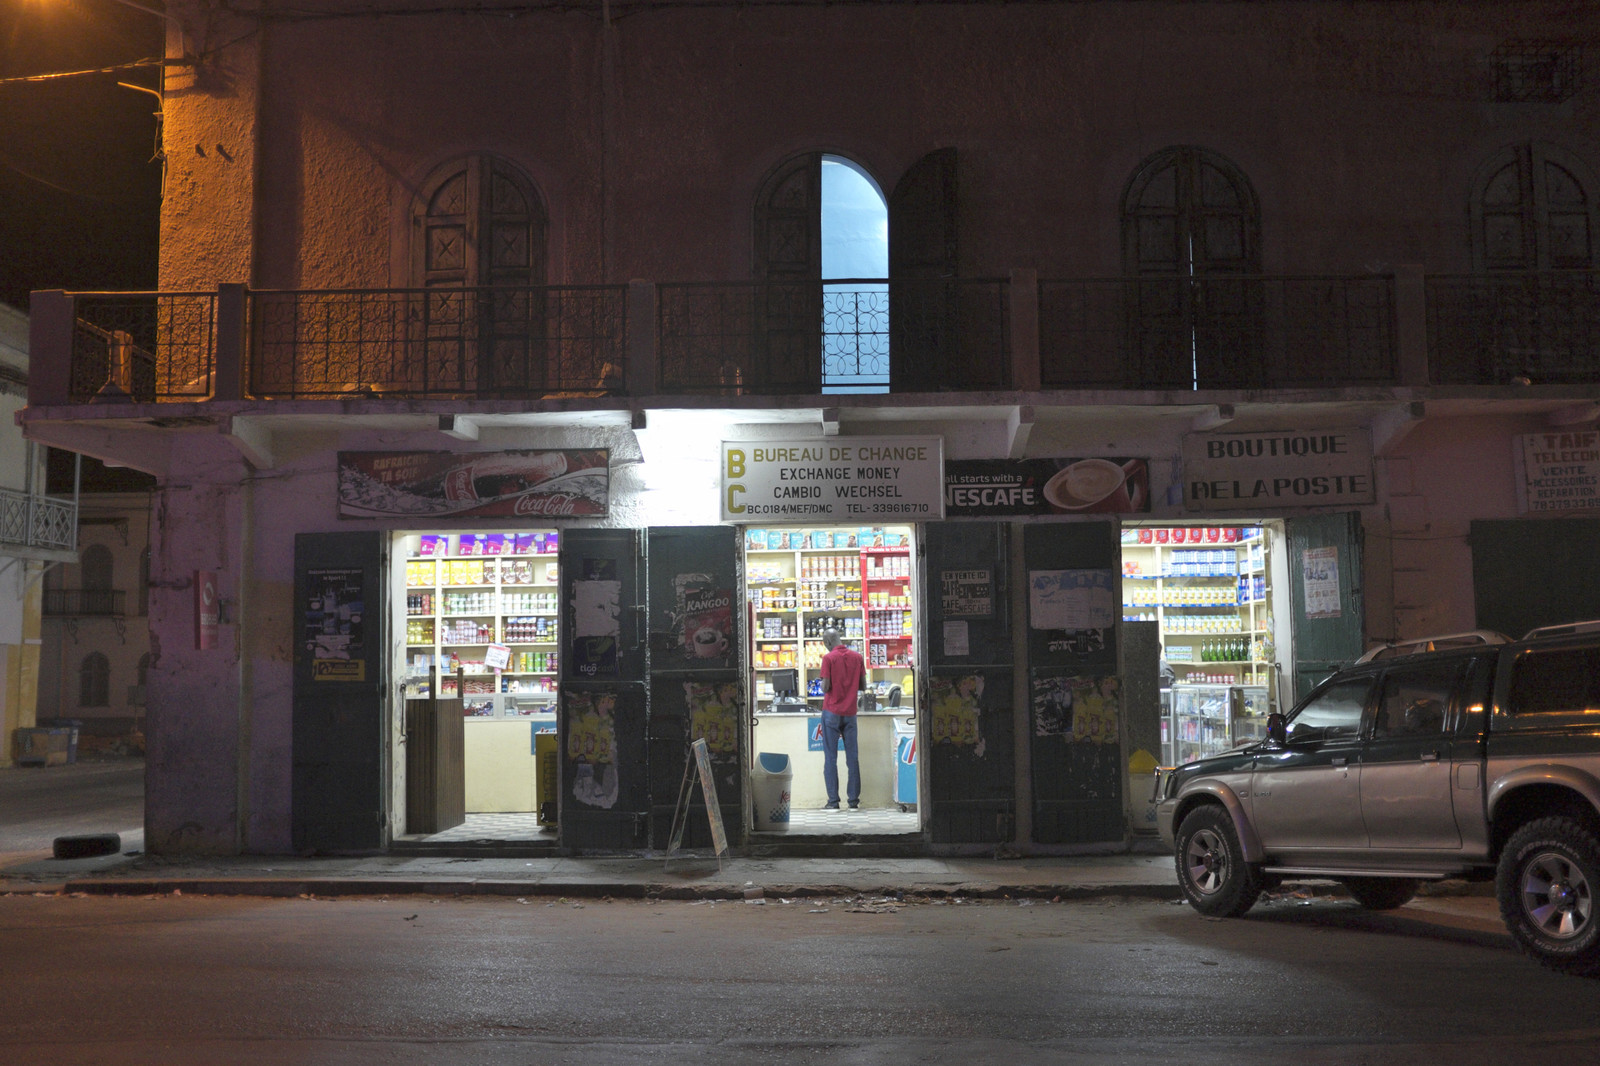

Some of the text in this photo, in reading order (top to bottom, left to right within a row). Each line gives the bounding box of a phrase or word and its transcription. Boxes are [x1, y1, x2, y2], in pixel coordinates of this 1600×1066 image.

[1206, 434, 1348, 458] BOUTIQUE
[753, 446, 928, 462] BUREAU DE CHANGE
[728, 449, 746, 478] B
[780, 467, 900, 480] EXCHANGE MONEY
[1542, 466, 1586, 476] VENTE
[960, 474, 990, 484] starts
[992, 474, 1014, 482] with
[1534, 476, 1598, 488] ACCESSOIRES
[728, 484, 746, 514] C
[774, 486, 902, 498] CAMBIO WECHSEL
[686, 597, 730, 612] KANGOO
